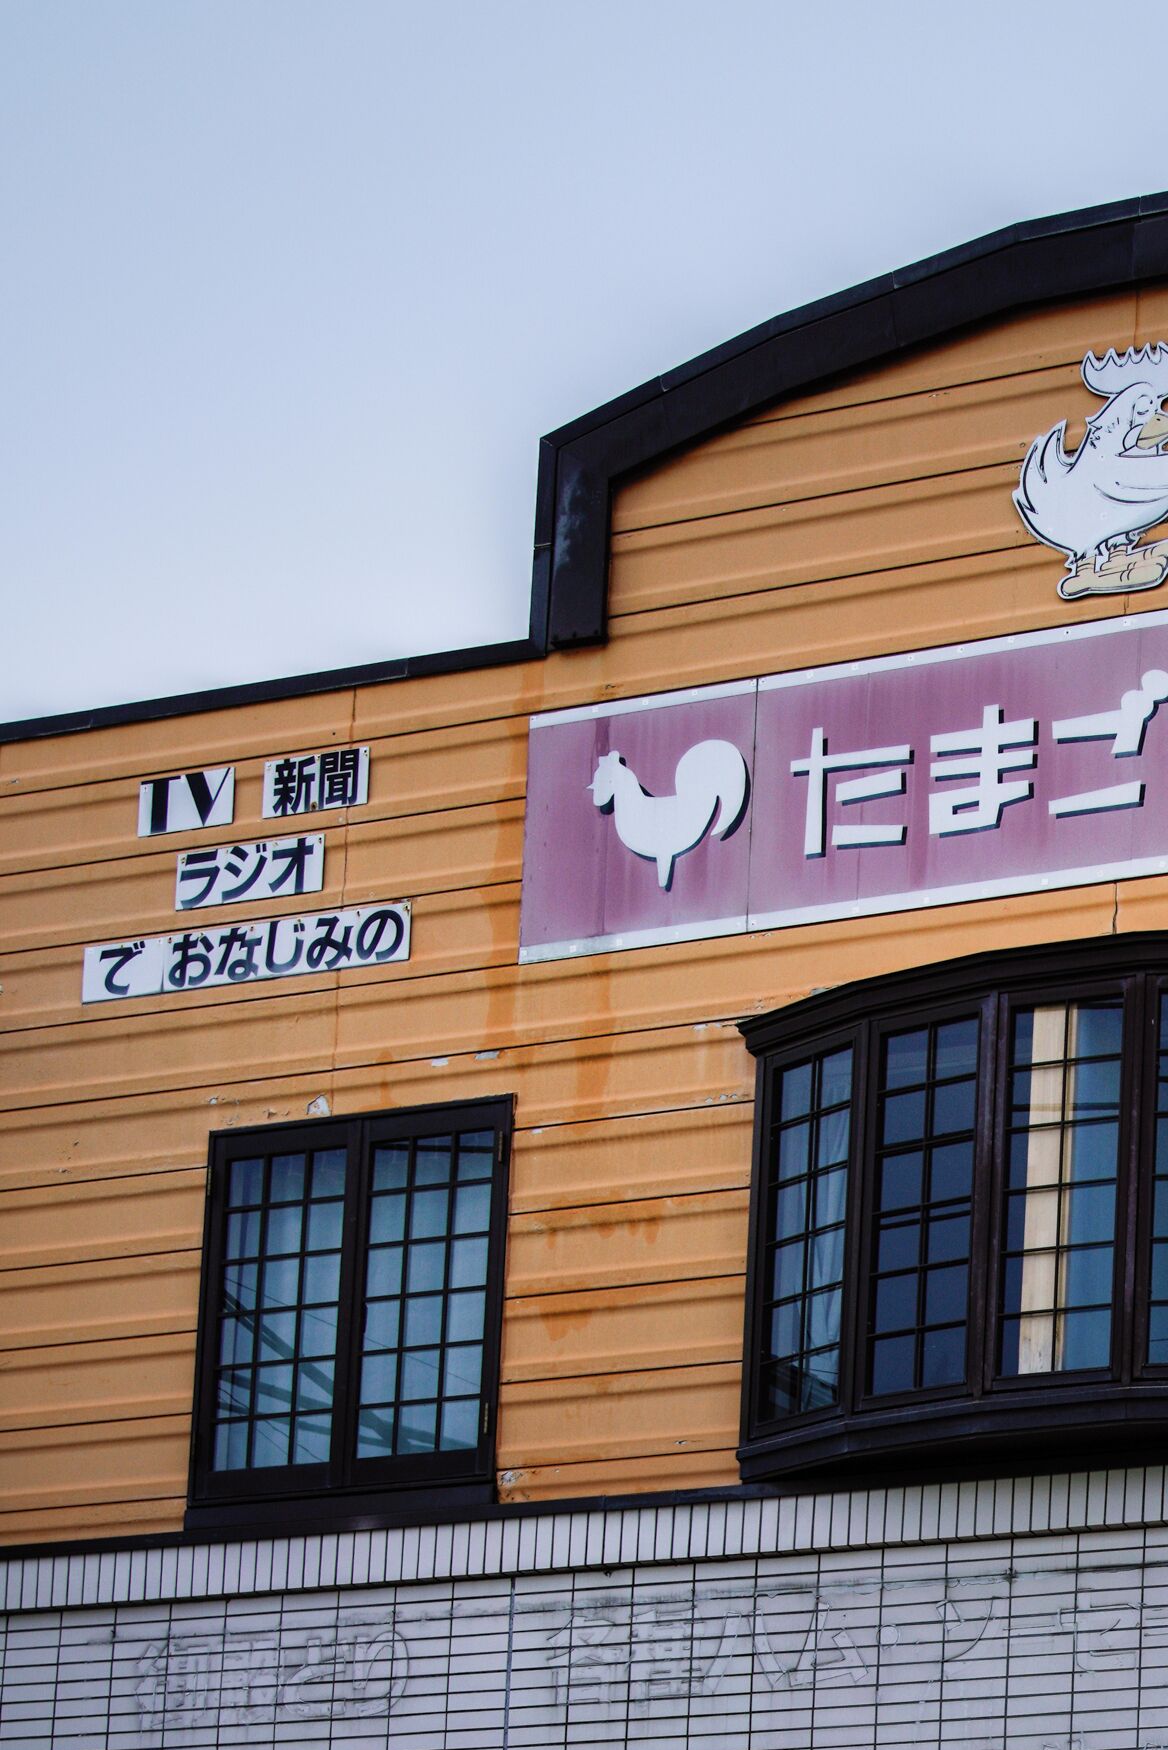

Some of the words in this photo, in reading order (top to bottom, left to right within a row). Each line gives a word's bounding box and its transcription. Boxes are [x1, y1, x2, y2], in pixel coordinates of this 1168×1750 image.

[141, 767, 231, 833] TV
[273, 748, 360, 815] 新聞
[180, 837, 314, 910] ラジオ
